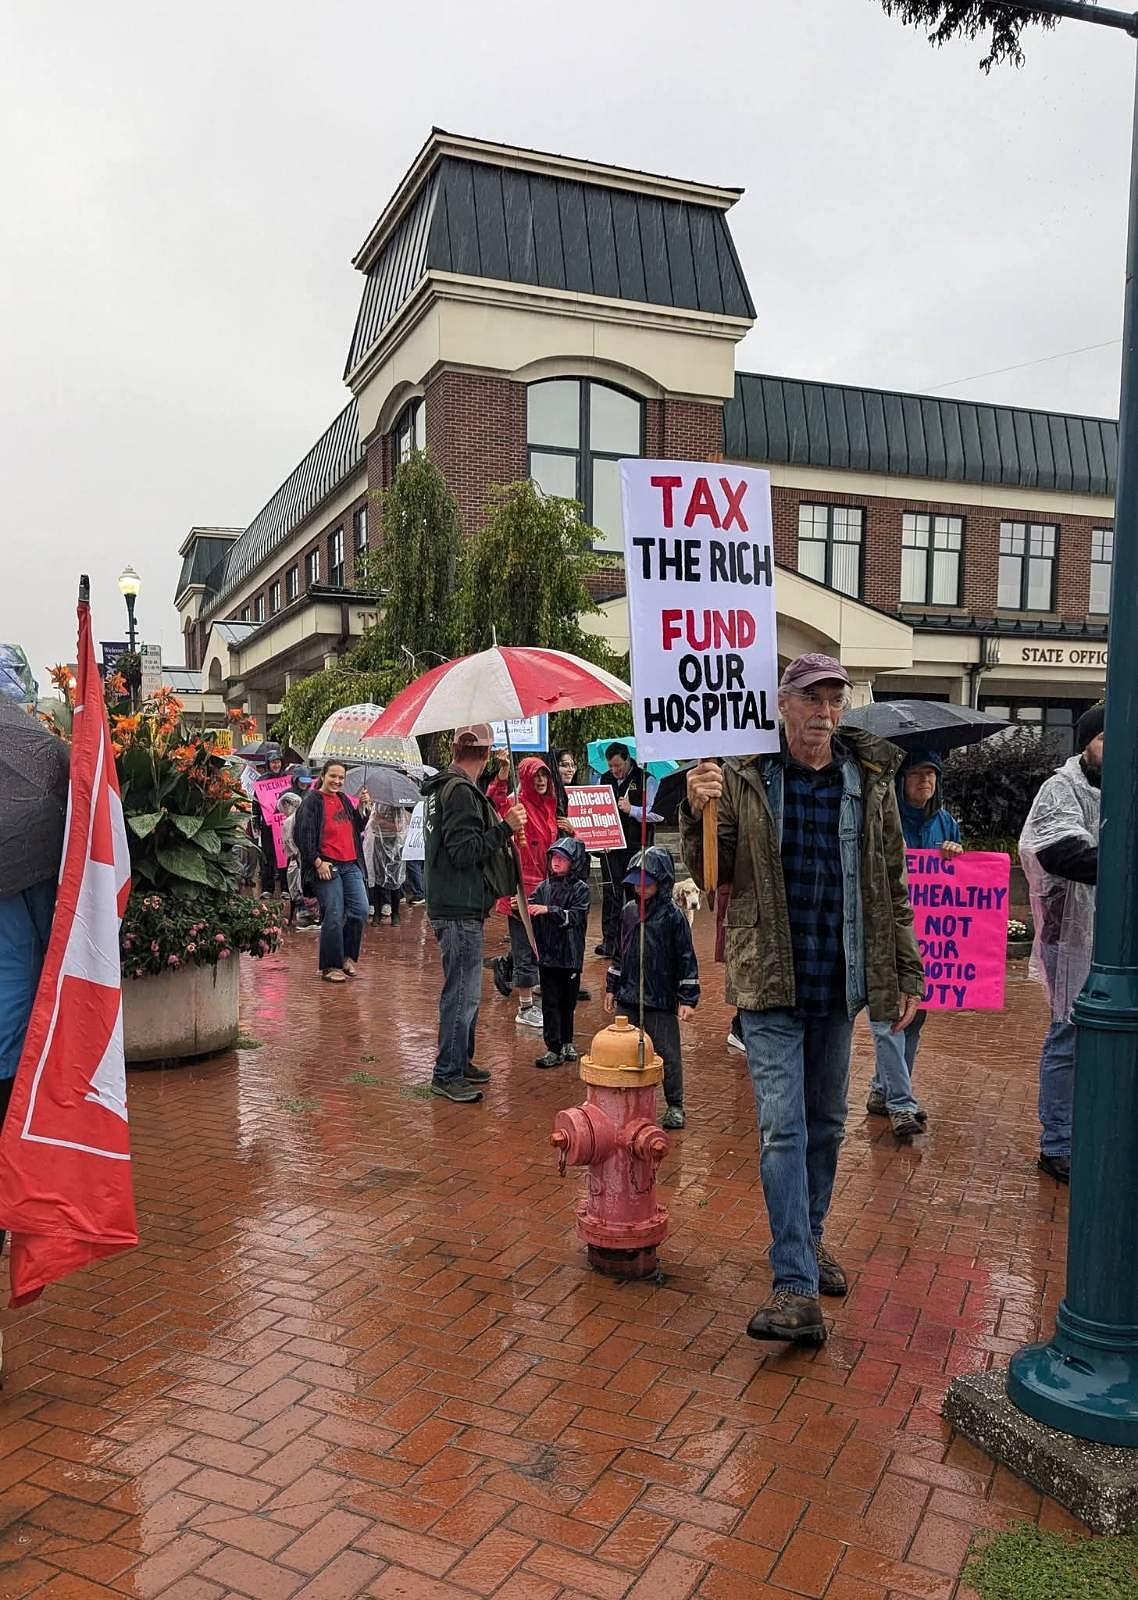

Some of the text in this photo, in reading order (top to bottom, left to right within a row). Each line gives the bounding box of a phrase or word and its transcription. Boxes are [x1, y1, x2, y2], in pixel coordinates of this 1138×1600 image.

[650, 475, 748, 533] TAX
[633, 537, 773, 587] THE RICH
[661, 608, 757, 652] FUND
[679, 653, 746, 693] OUR
[1022, 647, 1063, 663] STATE
[644, 690, 775, 734] HOSPITAL
[592, 813, 618, 828] Right
[924, 915, 973, 937] NOT
